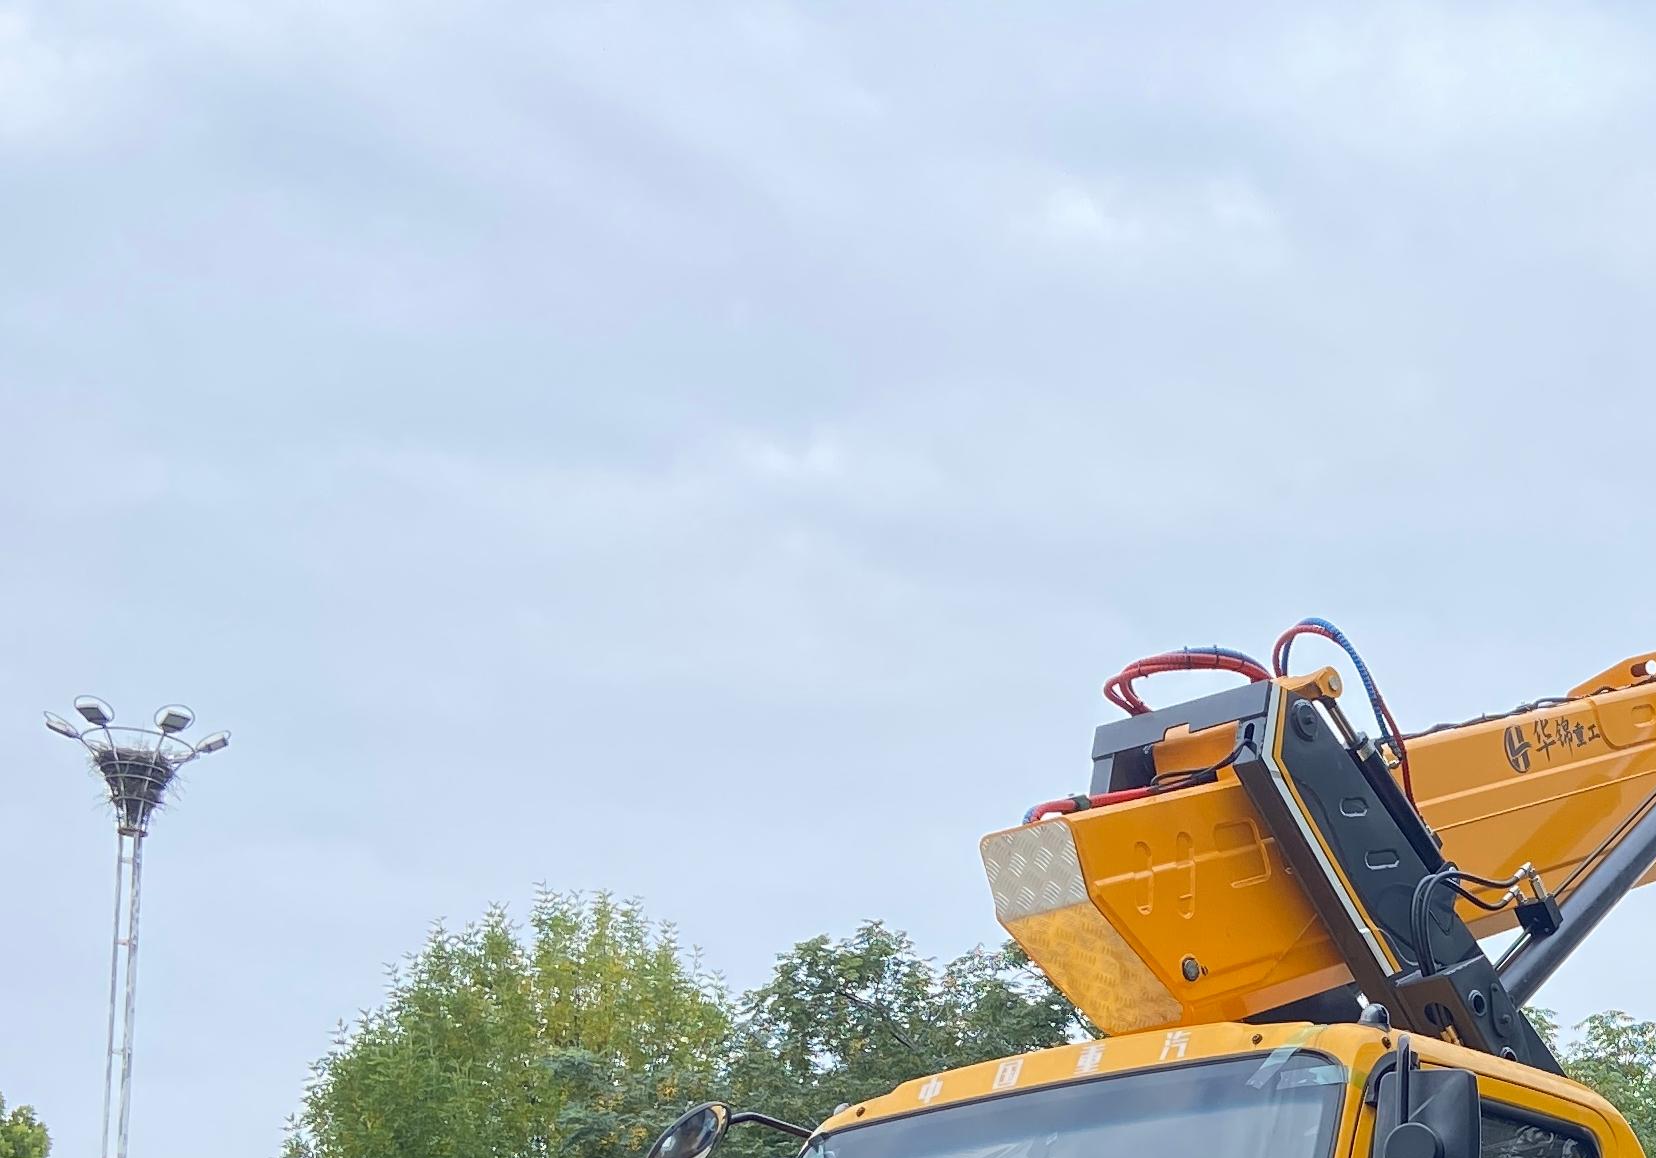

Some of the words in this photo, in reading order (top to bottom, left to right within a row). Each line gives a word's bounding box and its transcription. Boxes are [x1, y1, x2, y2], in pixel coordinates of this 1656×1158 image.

[1533, 716, 1600, 762] 华锦重工
[918, 1031, 1193, 1105] 中国重汽
